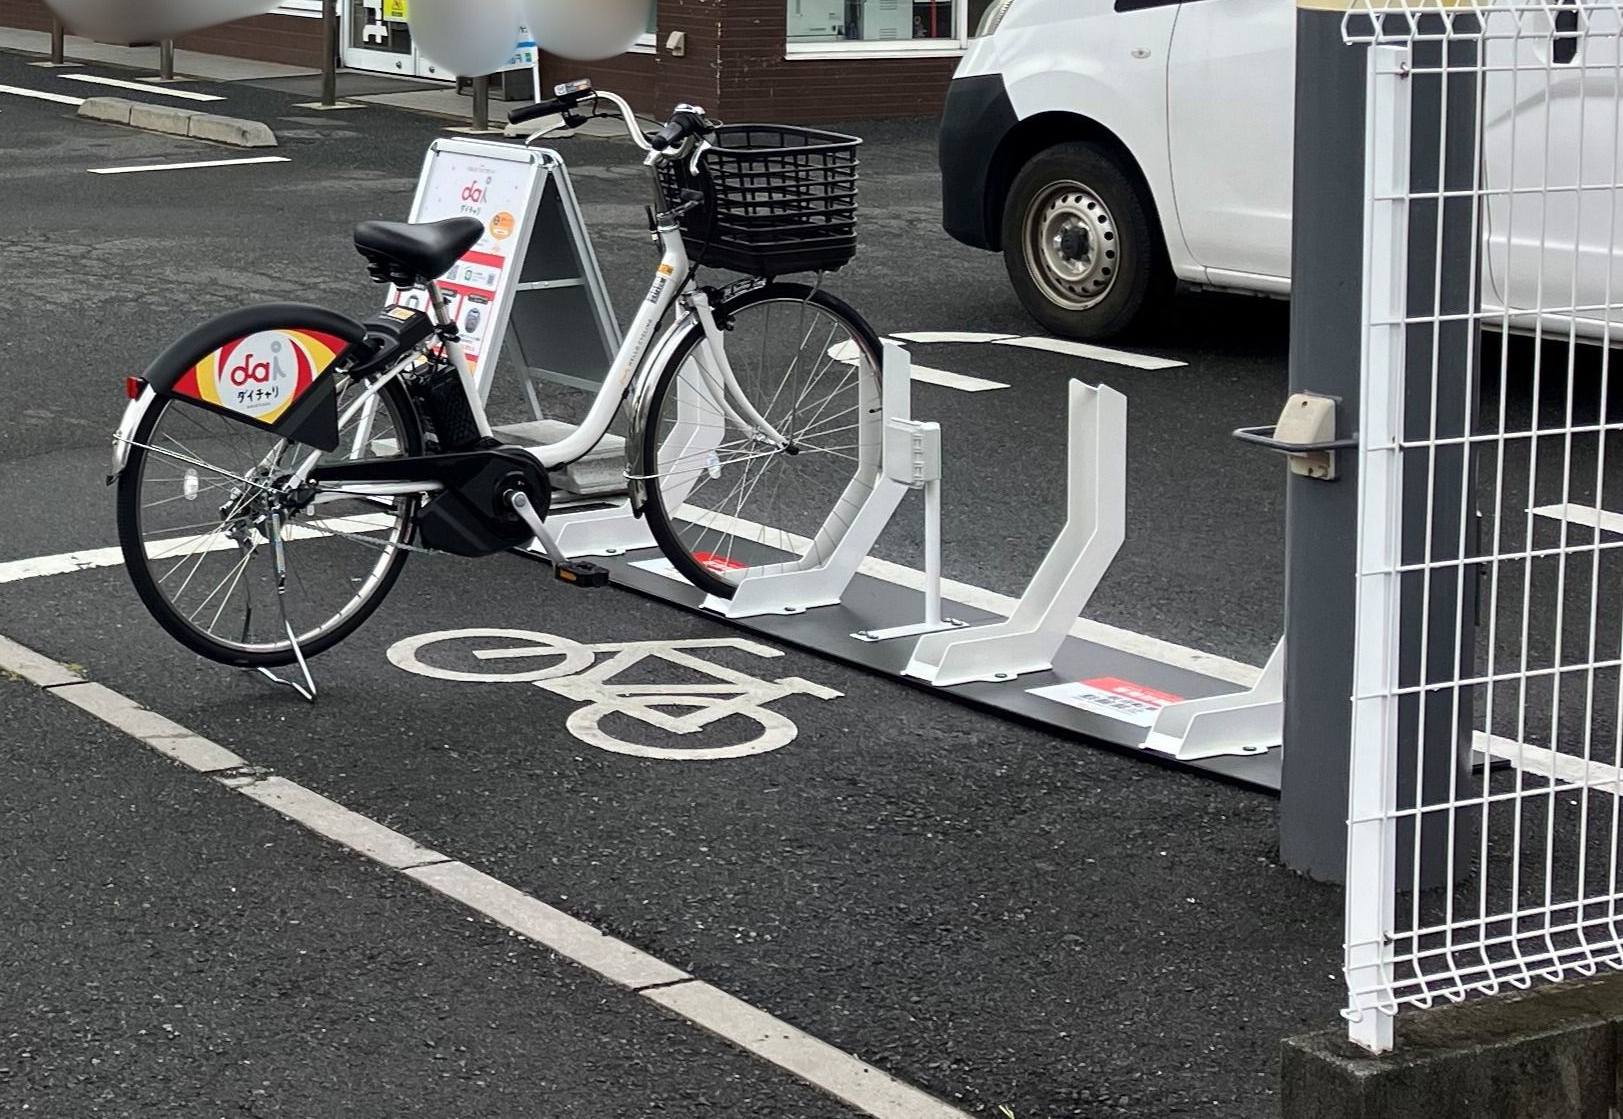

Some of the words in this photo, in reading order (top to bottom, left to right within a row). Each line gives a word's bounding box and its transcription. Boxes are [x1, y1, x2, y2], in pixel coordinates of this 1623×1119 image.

[461, 176, 493, 204] dai
[230, 340, 287, 387] dai
[237, 385, 280, 404] ダイチャリ
